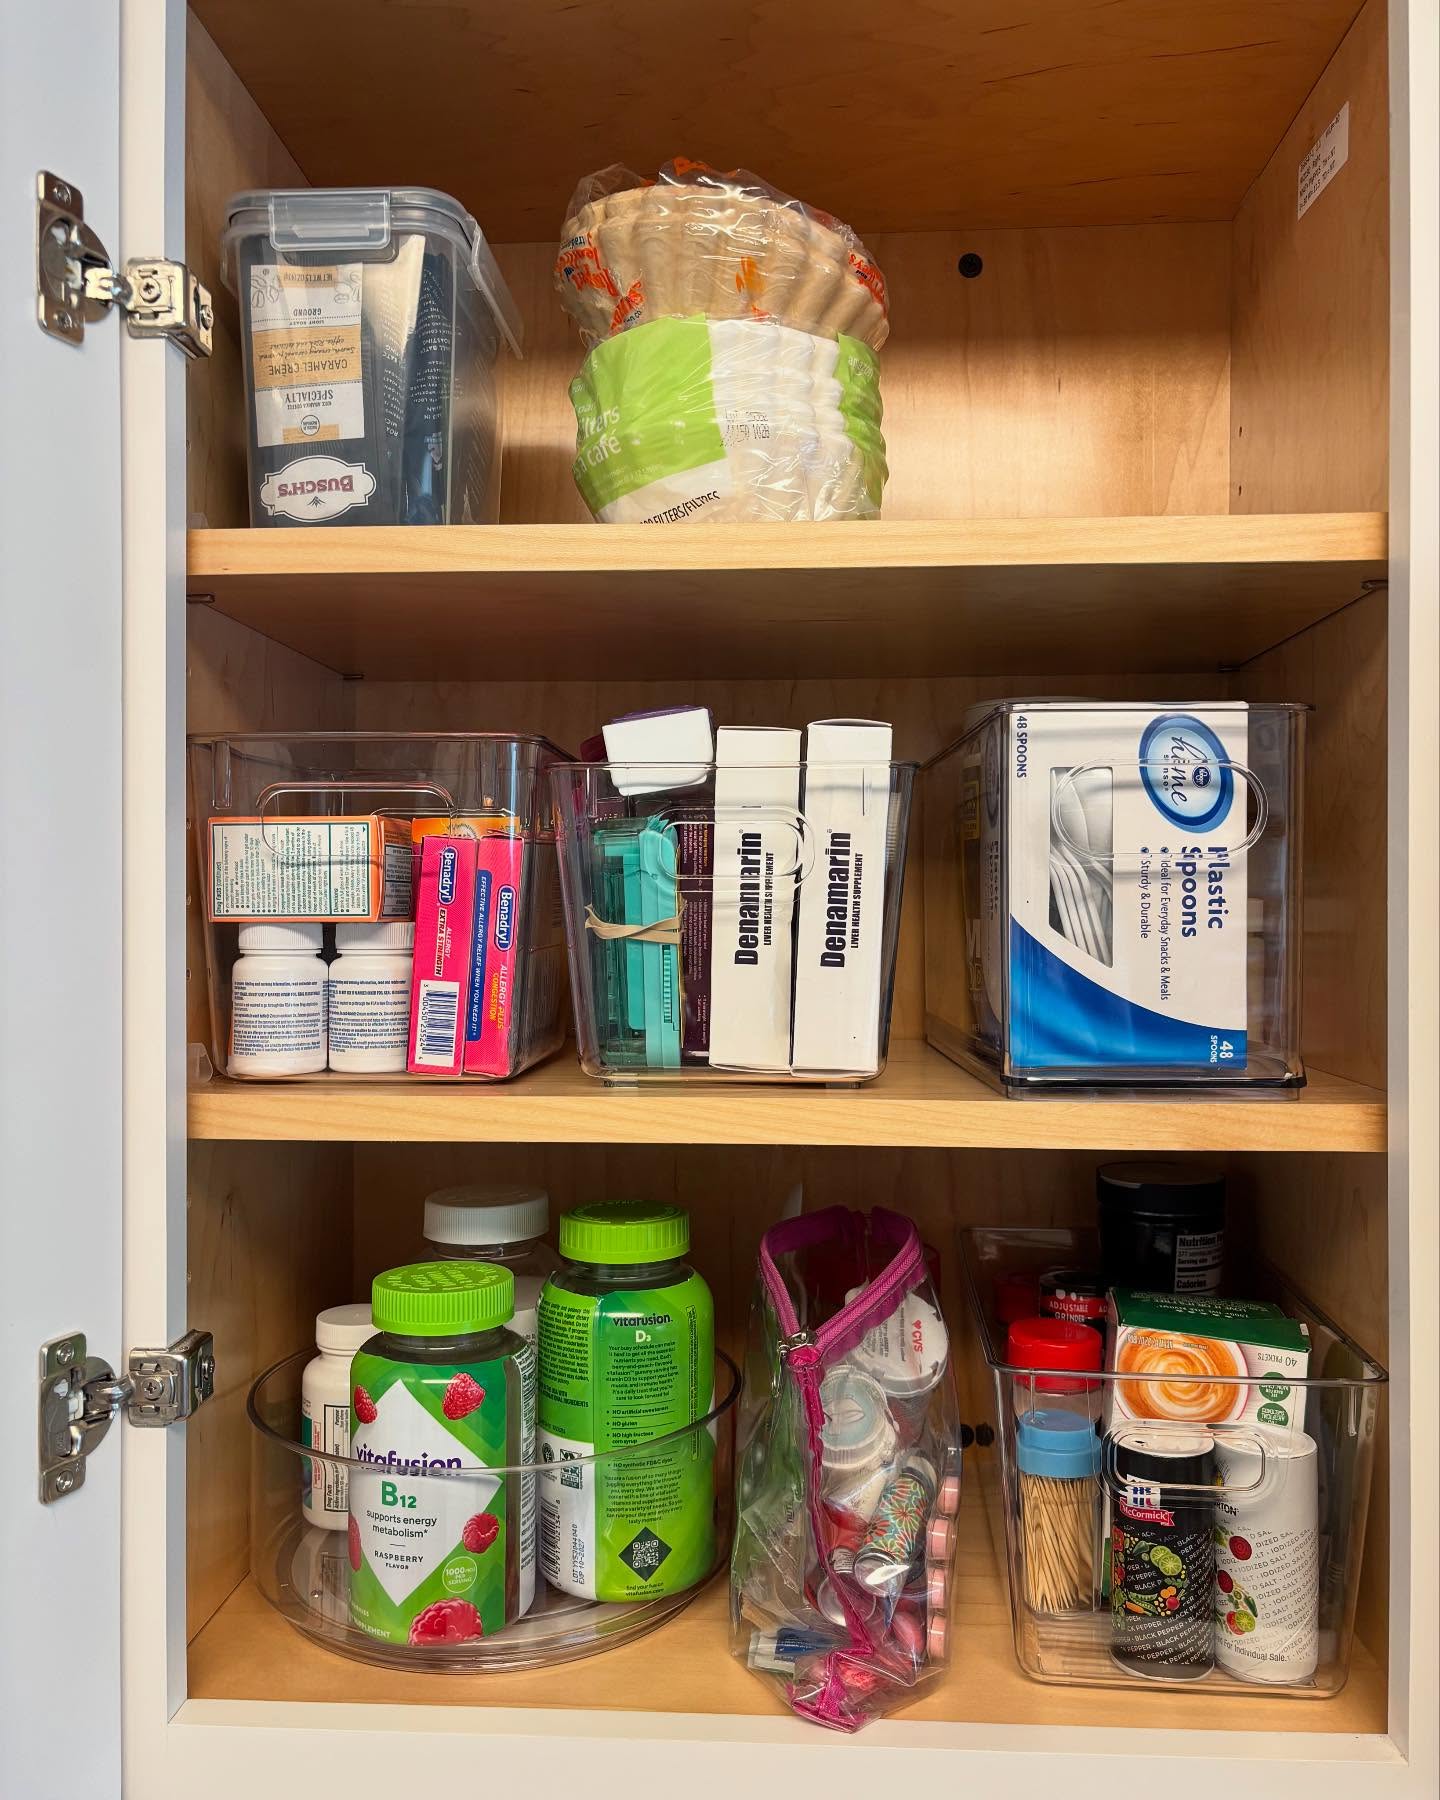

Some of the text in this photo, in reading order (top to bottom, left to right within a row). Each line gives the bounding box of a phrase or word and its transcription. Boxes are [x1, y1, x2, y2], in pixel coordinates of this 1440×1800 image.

[292, 308, 322, 317] GROUND
[267, 359, 348, 377] CARAMEL CRÈME
[284, 389, 334, 404] SPECIALTY
[587, 429, 622, 467] café
[277, 475, 354, 498] BUSCH'S
[1016, 715, 1028, 778] 48 SPOONS
[1162, 754, 1170, 787] snse
[440, 851, 456, 900] Benadryl
[765, 852, 774, 898] SPPEMENT
[479, 876, 487, 911] EFFECTIVE
[734, 832, 761, 965] Denamarin
[1175, 846, 1204, 938] Spoons
[1207, 846, 1231, 929] Plastic
[820, 832, 851, 967] Denamarin
[850, 852, 863, 949] LIVER HEALTH SUPPLEMENT
[1138, 860, 1151, 939] Sturdy & Durable
[477, 912, 485, 943] ALLERGY
[496, 890, 514, 945] Benadryl
[764, 926, 772, 946] LIVER
[1157, 860, 1172, 1001] Ideal for Everyday Snacks & Meals
[435, 908, 446, 976] EXTRA STRENGTH
[475, 943, 484, 967] RELIEF
[474, 967, 482, 986] WHEN
[498, 964, 508, 1005] ALLERGY
[489, 972, 499, 1021] CONGESTION
[471, 1003, 479, 1022] NEED
[1209, 1034, 1218, 1063] SPOONS
[1219, 1040, 1234, 1059] 48
[1049, 1300, 1089, 1313] ADJUSTABLE
[1054, 1311, 1085, 1323] GRINDER
[613, 1313, 671, 1327] vitafusion
[635, 1329, 652, 1343] D3
[912, 1330, 923, 1352] CVS
[1285, 1356, 1297, 1367] 40
[356, 1443, 462, 1476] vitafusion
[381, 1480, 417, 1508] B12
[366, 1510, 438, 1527] supports energy
[1122, 1504, 1168, 1520] McCormick
[1270, 1535, 1300, 1554] IODIZED
[374, 1550, 424, 1563] RASPBERRY
[385, 1562, 409, 1570] FLAVOR
[1238, 1561, 1269, 1573] IODIZED
[1269, 1553, 1287, 1565] SALT
[1260, 1551, 1306, 1579] IODIZED SALT
[1259, 1559, 1309, 1590] SALT IODIZED
[1282, 1579, 1299, 1591] SALT
[1134, 1581, 1157, 1591] BLACK
[1272, 1587, 1302, 1606] IODIZED
[1135, 1620, 1162, 1631] PEPPER
[1167, 1609, 1190, 1623] BLACK
[1272, 1605, 1289, 1616] SALT
[1285, 1609, 1310, 1630] IODIZED
[1293, 1602, 1308, 1616] SALT
[1134, 1631, 1157, 1642] BLACK
[1157, 1622, 1184, 1636] PEPPER
[1155, 1634, 1180, 1648] BLACK
[1179, 1619, 1202, 1638] PEPPER
[1146, 1634, 1199, 1660] PEPPER BLACK
[1169, 1646, 1194, 1664] PEPPER
[1234, 1644, 1267, 1661] Individual
[1269, 1653, 1287, 1662] Sale.
